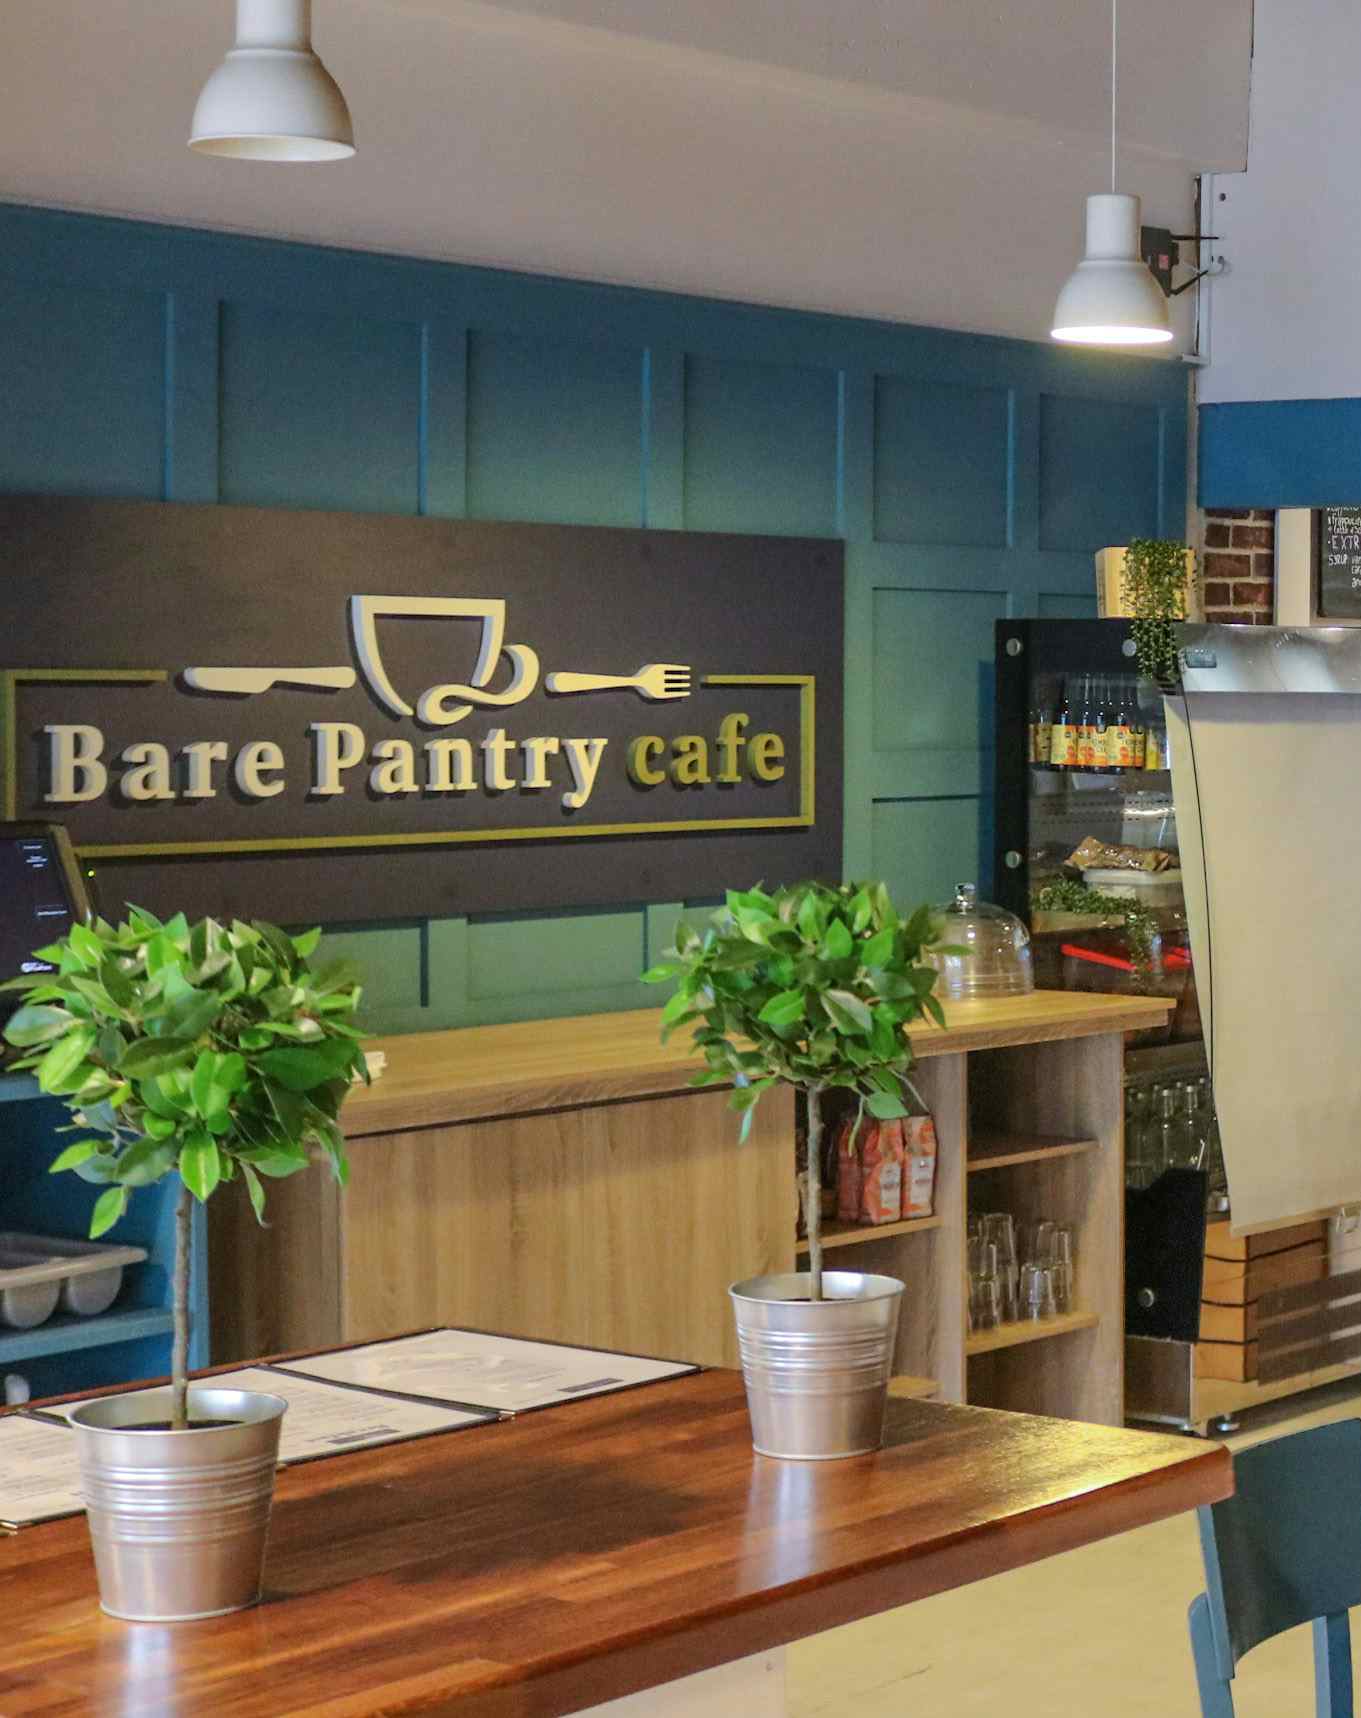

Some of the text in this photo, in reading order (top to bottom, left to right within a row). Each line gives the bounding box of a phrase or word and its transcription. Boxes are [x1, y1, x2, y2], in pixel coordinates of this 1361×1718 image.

[44, 713, 786, 809] Bare Pantry cafe
